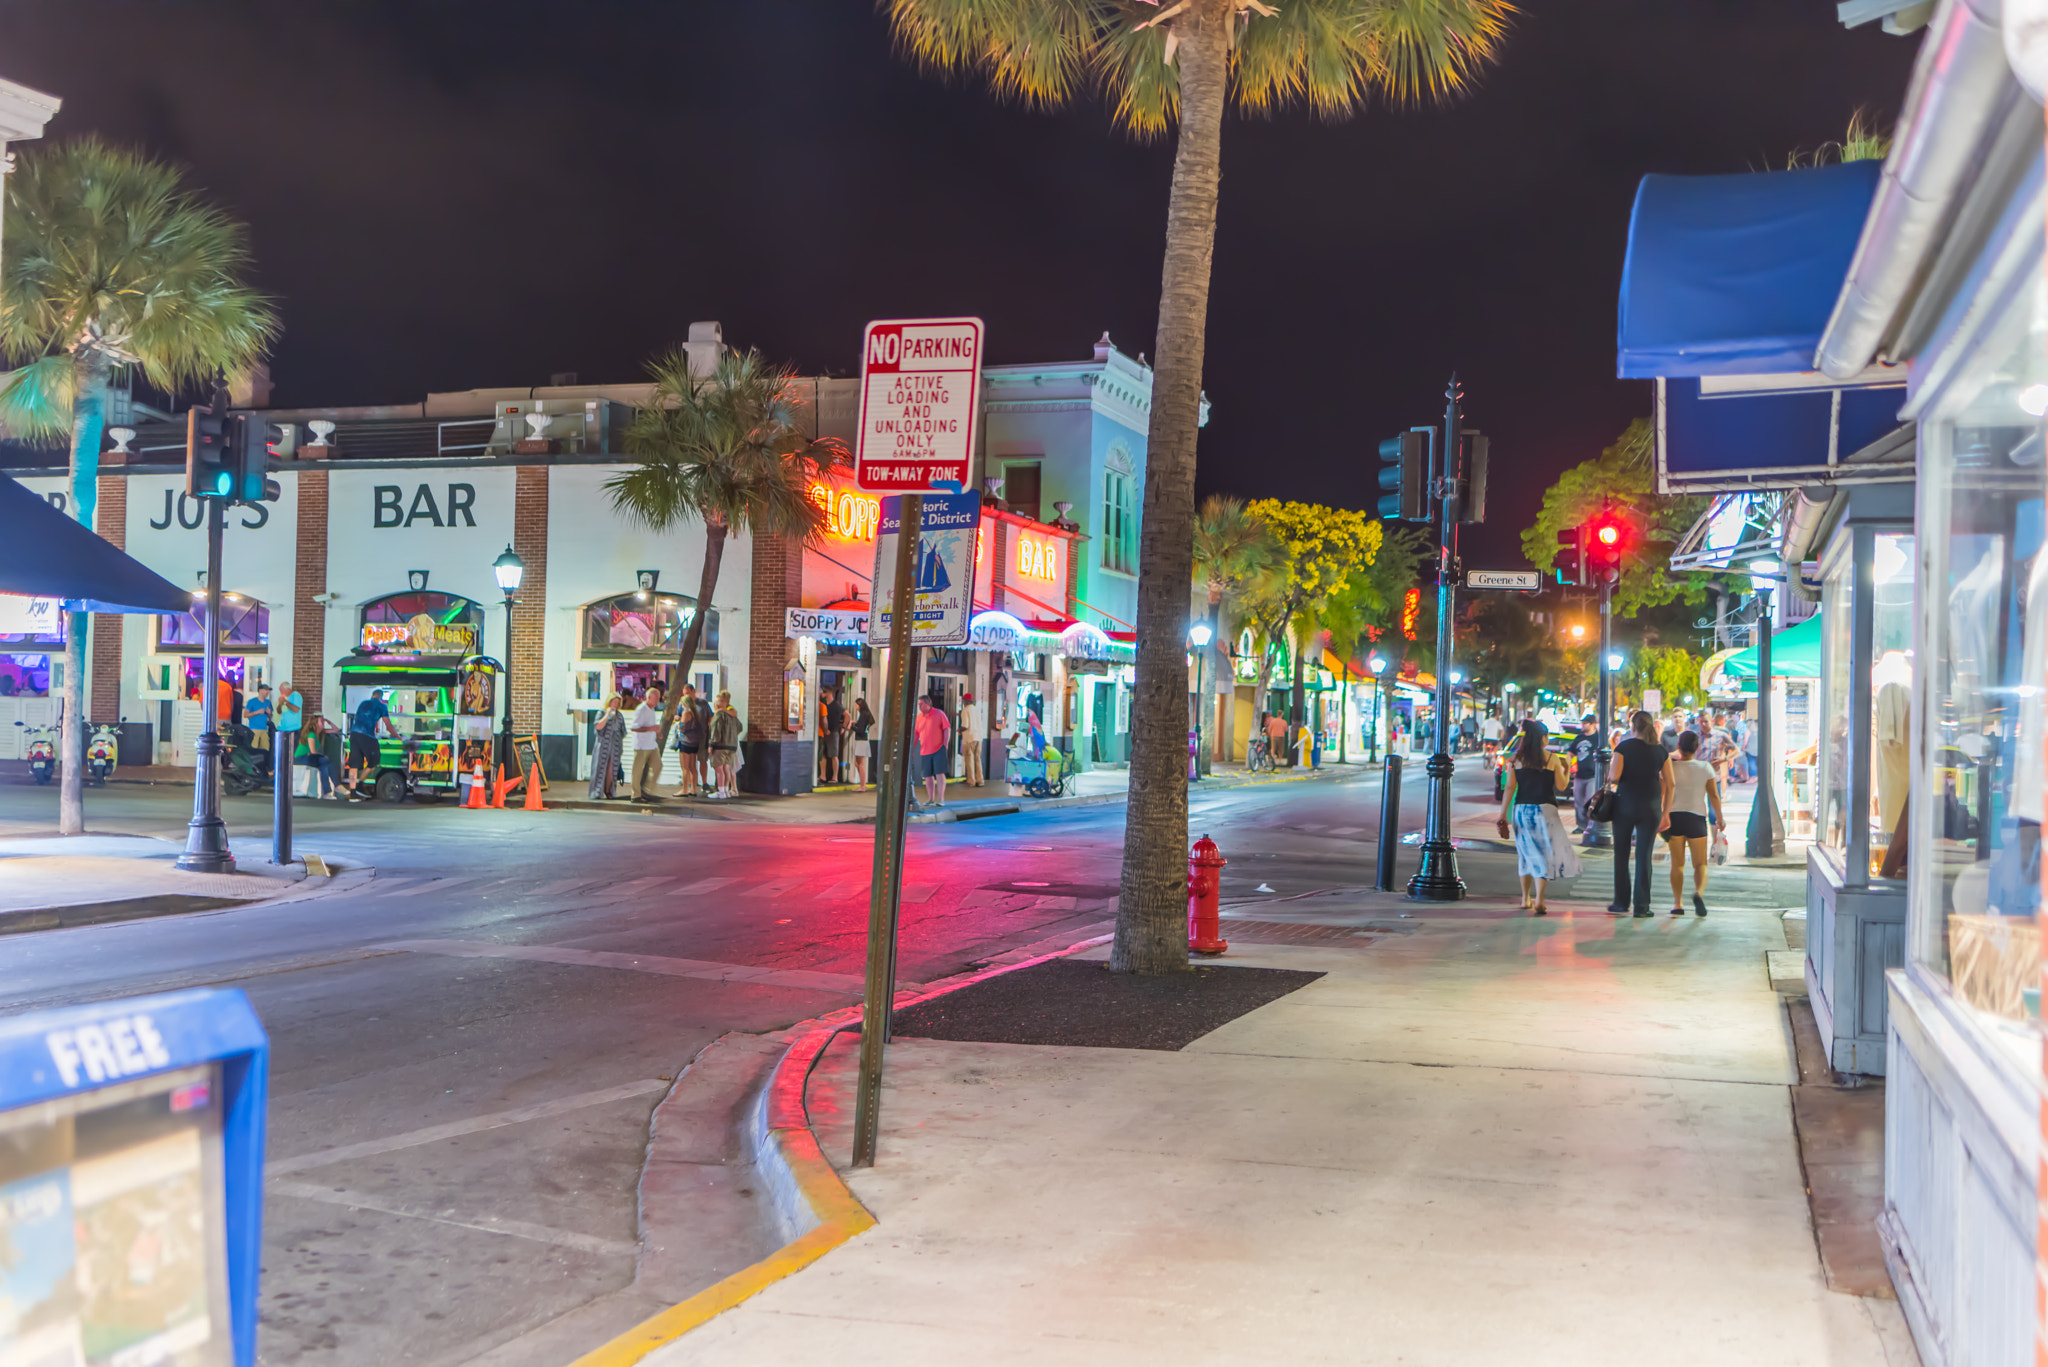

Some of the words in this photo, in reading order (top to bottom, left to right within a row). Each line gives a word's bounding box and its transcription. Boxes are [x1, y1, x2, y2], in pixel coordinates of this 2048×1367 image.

[869, 333, 900, 364] NO
[903, 337, 973, 359] PARKING
[894, 376, 944, 390] ACTIVE
[887, 390, 949, 404] LOADING
[902, 405, 931, 418] AND
[875, 419, 958, 434] UNLOADING
[896, 434, 934, 448] ONLY
[866, 466, 924, 482] TOW-AWAY
[928, 466, 960, 481] ZONE
[373, 483, 477, 528] BAR
[928, 512, 971, 525] District
[1019, 540, 1056, 580] BAR
[1478, 574, 1513, 585] Greene
[1516, 575, 1527, 585] St
[792, 614, 842, 630] SLOPPY
[364, 626, 406, 646] Pete's
[434, 626, 474, 646] Meats
[47, 1015, 170, 1088] FREE
